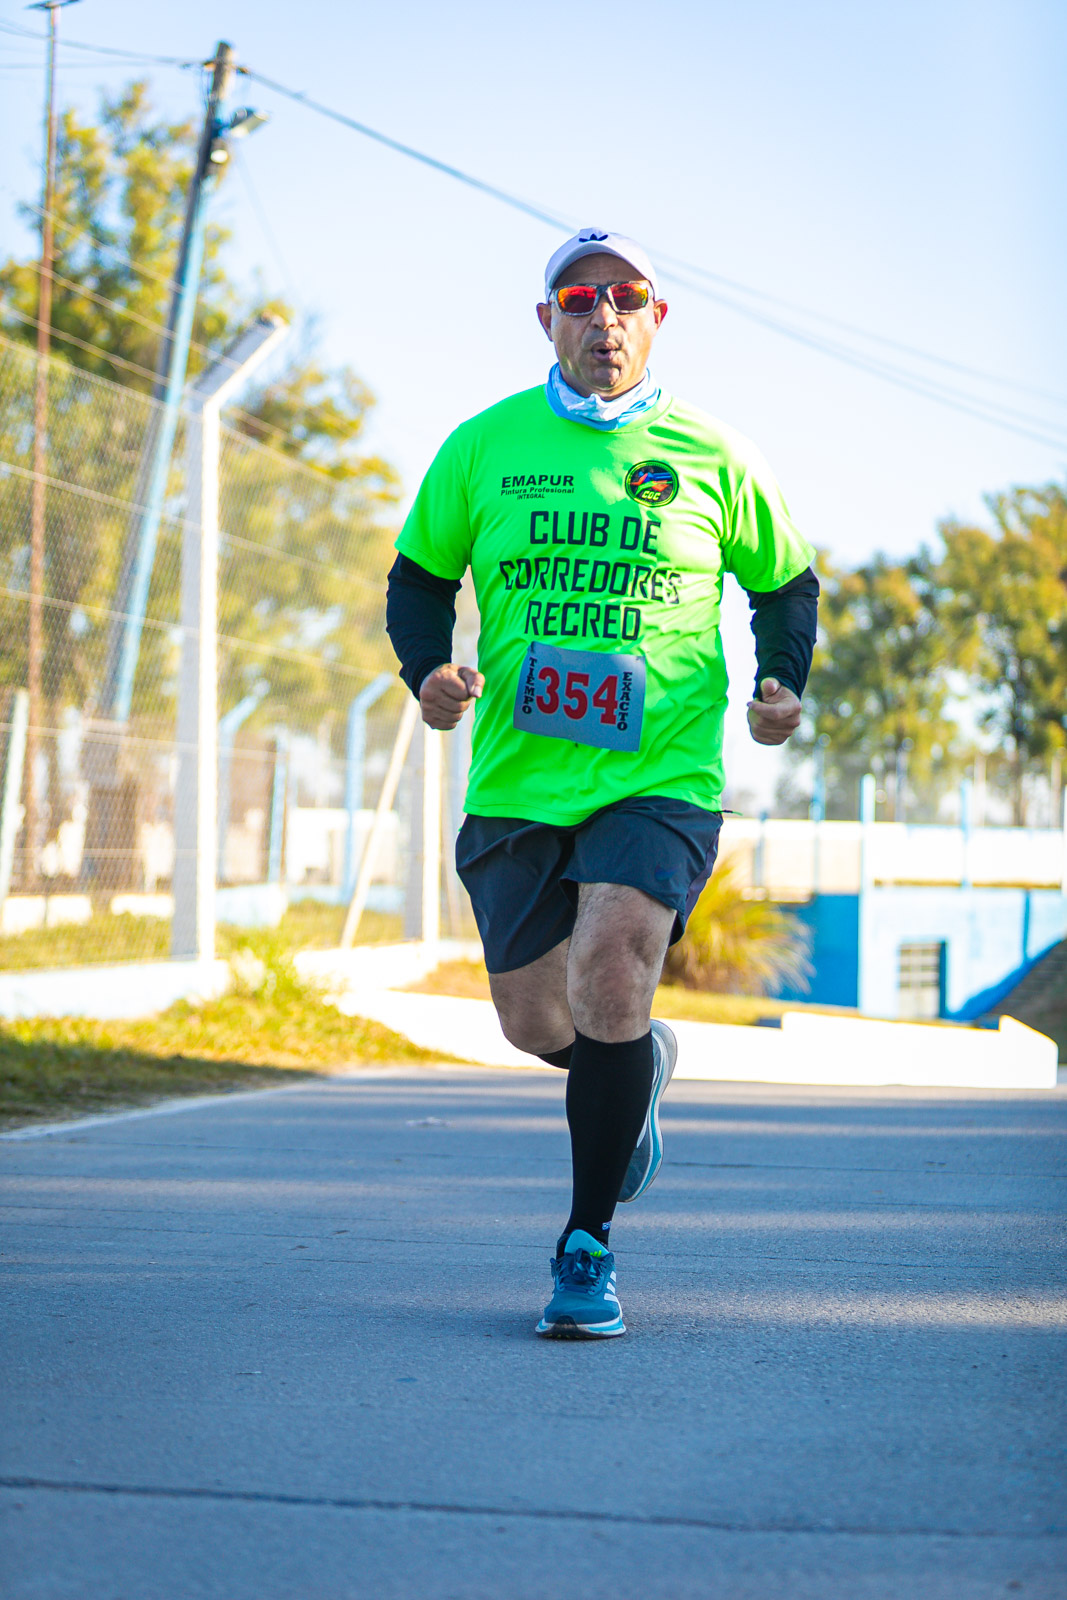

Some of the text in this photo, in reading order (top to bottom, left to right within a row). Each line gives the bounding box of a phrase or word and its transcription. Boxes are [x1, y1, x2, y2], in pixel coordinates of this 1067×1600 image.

[501, 488, 527, 496] Pintura
[502, 475, 574, 488] EMAPUR
[530, 511, 661, 555] CLUB DE
[499, 557, 682, 604] CORREDORES
[524, 601, 641, 640] RECREO
[522, 657, 537, 714] TIEMPO
[536, 666, 618, 725] 354
[616, 671, 632, 731] EXACTO
